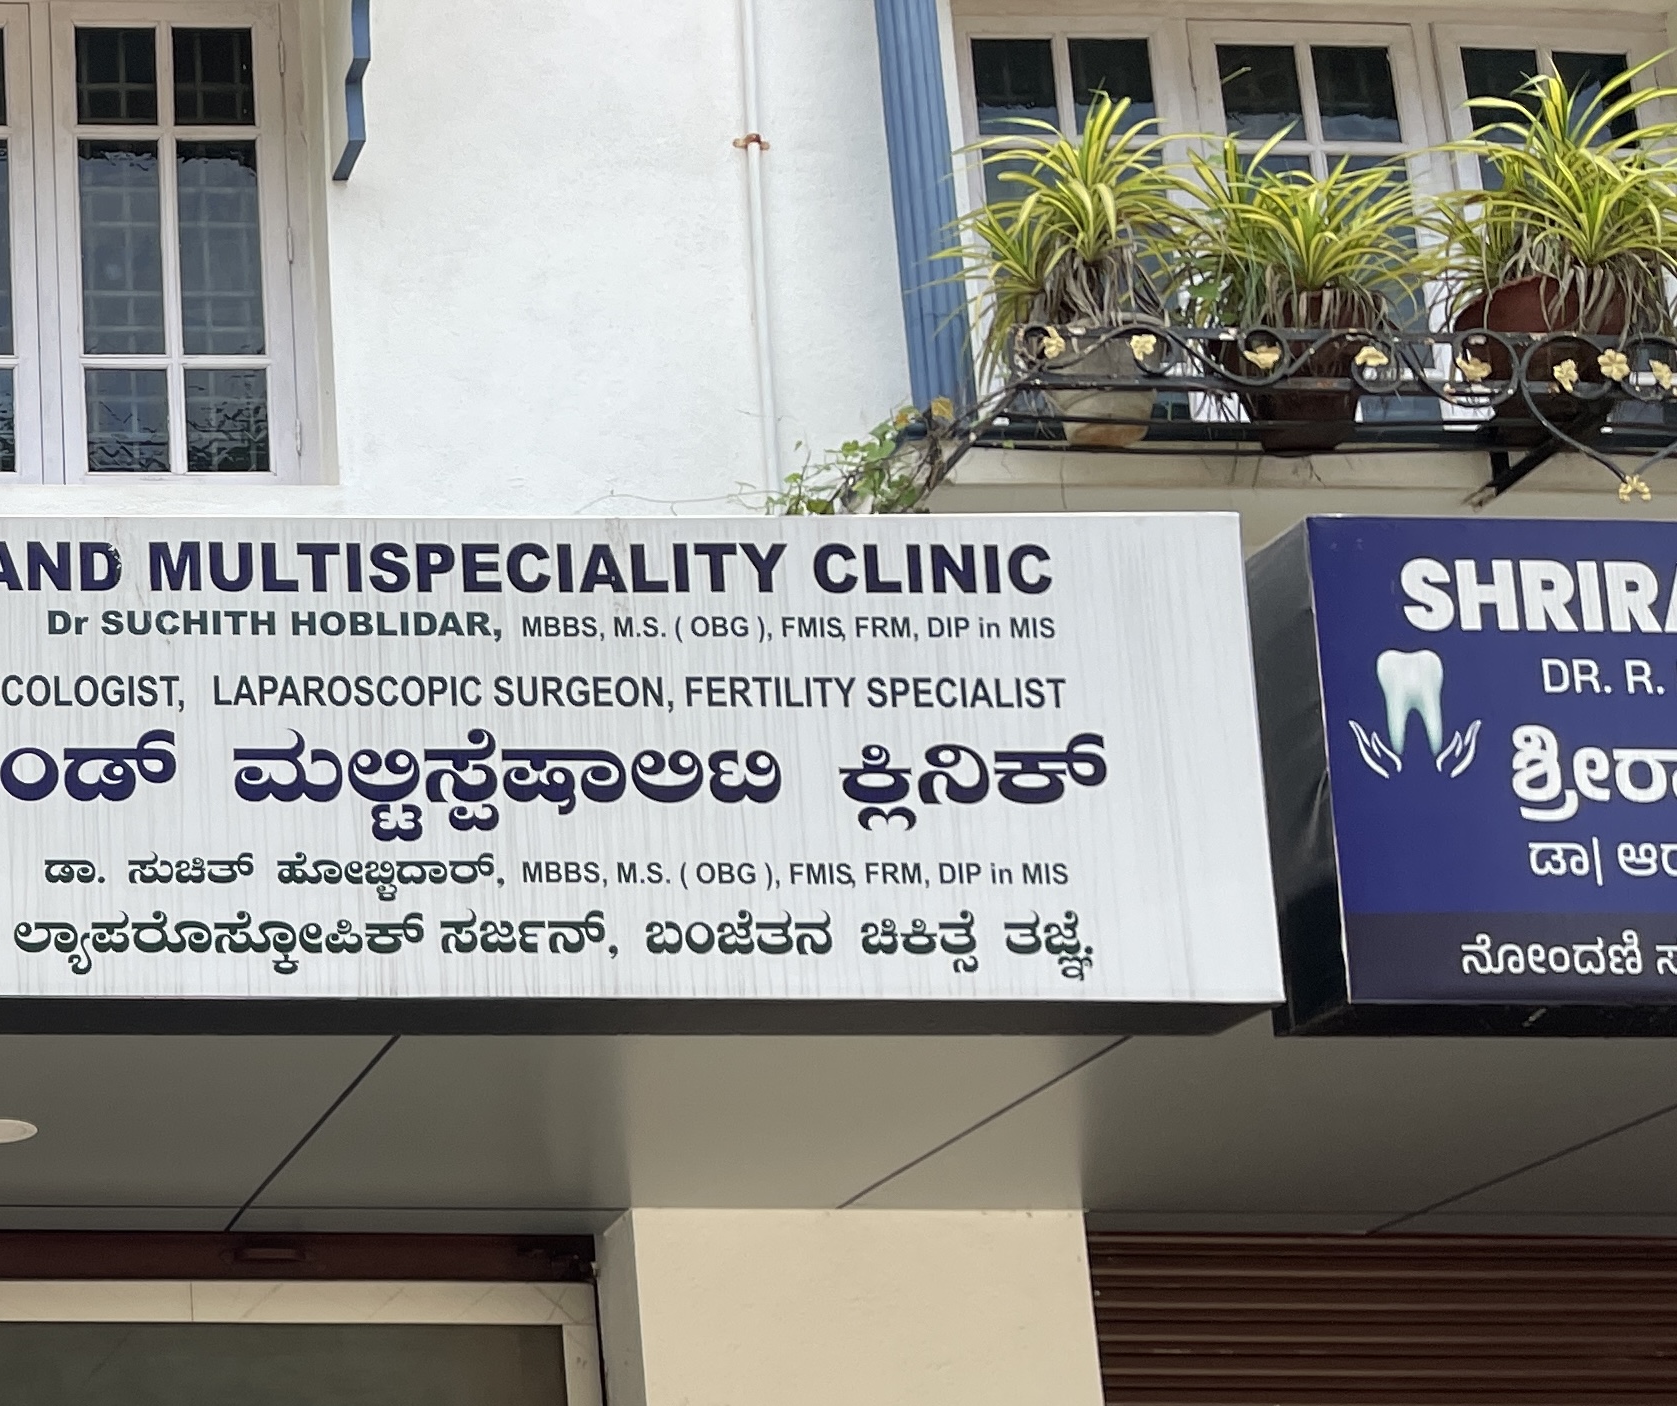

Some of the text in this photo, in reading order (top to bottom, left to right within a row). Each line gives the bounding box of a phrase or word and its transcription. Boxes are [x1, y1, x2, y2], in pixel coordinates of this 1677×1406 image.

[148, 541, 788, 594] MULTISPECIALITY
[813, 543, 1053, 595] CLINIC
[1400, 557, 1677, 633] SHRIR
[47, 610, 89, 635] Dr
[101, 610, 276, 636] SUCHITH
[291, 611, 502, 643] HOBLIDAR,
[522, 616, 605, 642] MBBS,
[613, 616, 670, 638] M.S.
[781, 616, 847, 641] FMIS,
[855, 616, 919, 642] FRM,
[927, 616, 970, 638] DIP
[978, 616, 1002, 638] in
[1010, 617, 1055, 639] MIS
[213, 675, 482, 707] LAPAROSCOPIC
[493, 675, 674, 714] SURGEON,
[685, 676, 856, 708] FERTILITY
[867, 677, 1066, 709] SPECIALIST
[1541, 658, 1666, 695] DR. R.
[232, 728, 783, 842] ಮಲ್ಟಿಸ್ಪೆಷಾಲಿಟಿ
[838, 731, 1108, 831] ಕ್ಲಿನಿಕ್
[44, 858, 107, 884] ಡಾ.
[127, 851, 254, 884] ಸುಚಿತ್
[522, 861, 608, 888] MBBS,
[617, 862, 673, 884] M.S.
[789, 863, 856, 887] FMIS,
[865, 862, 930, 887] FRM,
[938, 862, 982, 884] DIP
[991, 863, 1013, 885] in
[1022, 863, 1068, 885] MIS
[644, 908, 833, 955] ಬಂಜೆತನ
[860, 910, 979, 974] ಚಿಕಿತ್ಸೆ
[1461, 929, 1644, 976] ನೋಂದಣಿ
